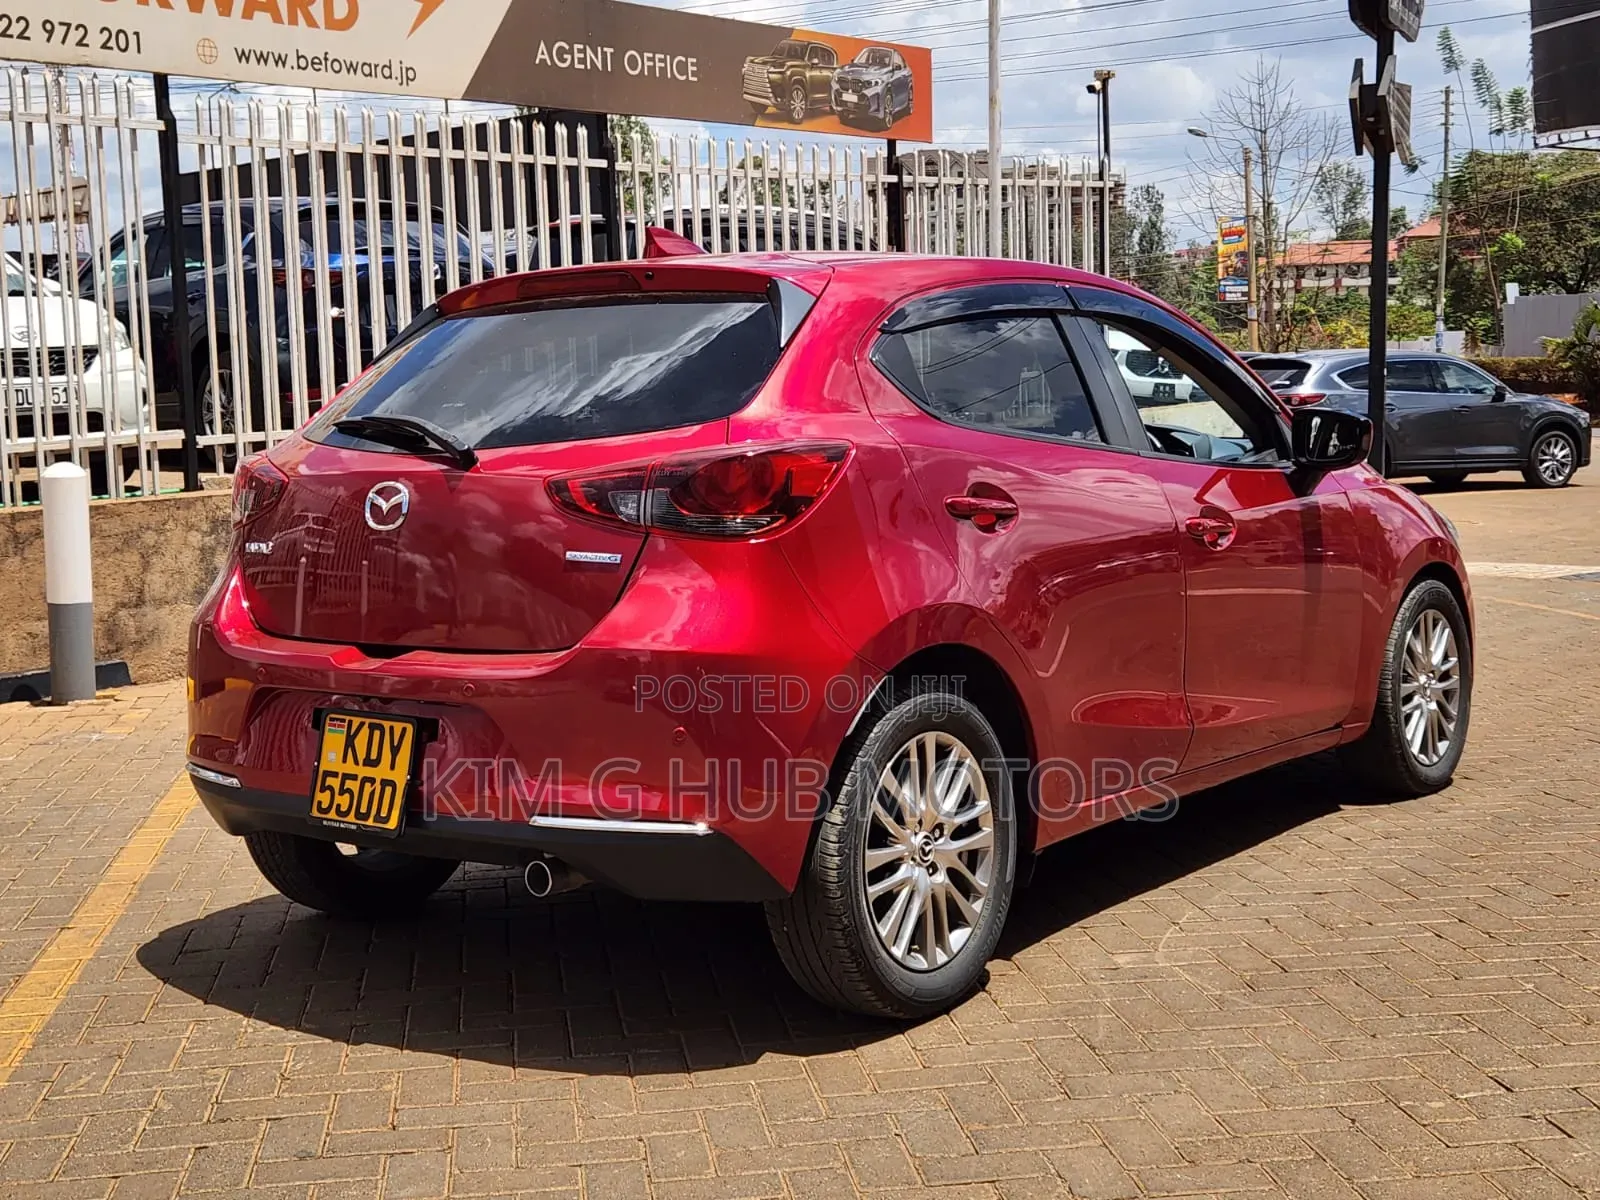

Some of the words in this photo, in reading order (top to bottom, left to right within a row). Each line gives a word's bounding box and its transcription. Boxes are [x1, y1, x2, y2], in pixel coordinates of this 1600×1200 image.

[41, 19, 90, 48] 972
[99, 26, 142, 54] 201
[234, 46, 417, 85] www.befoward.jp
[535, 39, 614, 72] AGENT
[623, 50, 698, 82] OFFICE
[341, 719, 408, 771] KDY
[316, 770, 398, 825] 550D
